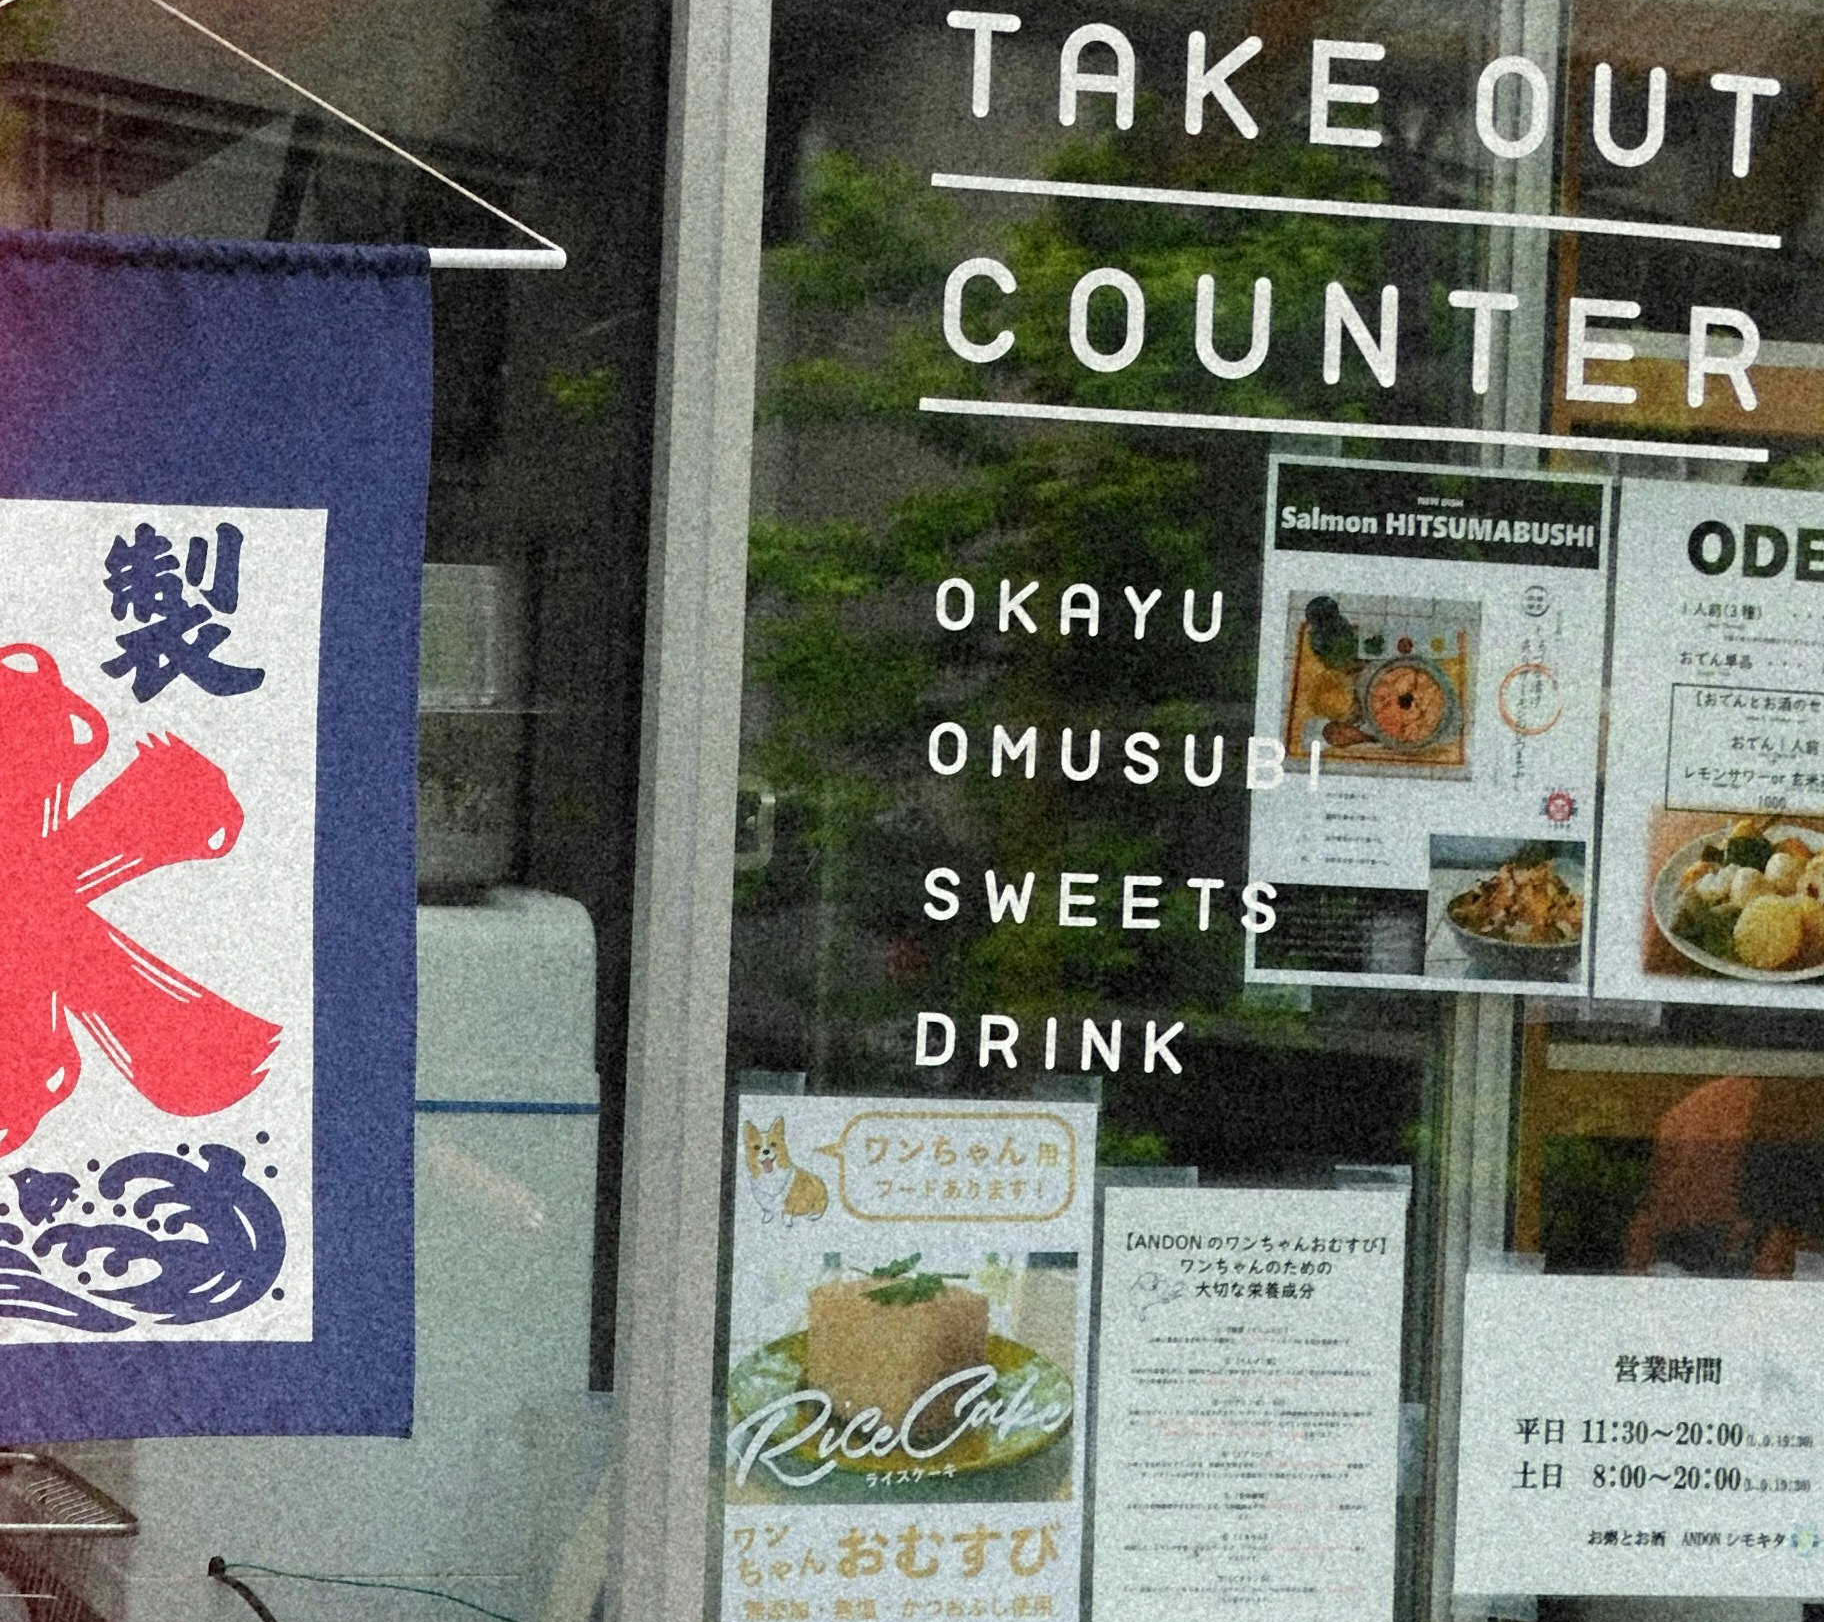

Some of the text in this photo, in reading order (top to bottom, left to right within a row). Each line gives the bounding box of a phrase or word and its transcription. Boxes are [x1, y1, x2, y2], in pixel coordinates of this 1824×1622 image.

[947, 10, 1781, 177] TAKE OUT
[942, 257, 1760, 412] COUNTER
[1280, 506, 1594, 548] Salmon HITSUMABUSHI
[1687, 519, 1824, 584] ODE
[101, 521, 267, 704] 製
[936, 578, 1224, 642] OKAYU
[927, 722, 1321, 792] OMUSUBI
[1791, 771, 1824, 788] 玄米
[924, 868, 1279, 935] SWEETS
[916, 1011, 1186, 1074] DRINK
[864, 1134, 1060, 1169] ワンちゃん用
[1180, 1258, 1333, 1276] ワンちゃんのための
[1195, 1281, 1315, 1300] 大切な栄養成分
[1614, 1354, 1723, 1386] 営業時間
[1514, 1417, 1566, 1446] 平日
[865, 1463, 957, 1488] ライスケーキ
[1511, 1461, 1564, 1490] 土日
[733, 1524, 791, 1554] ワン
[836, 1520, 1062, 1579] おむすび
[1587, 1530, 1667, 1548] お粥とお酒
[1726, 1532, 1786, 1549] シモキタ
